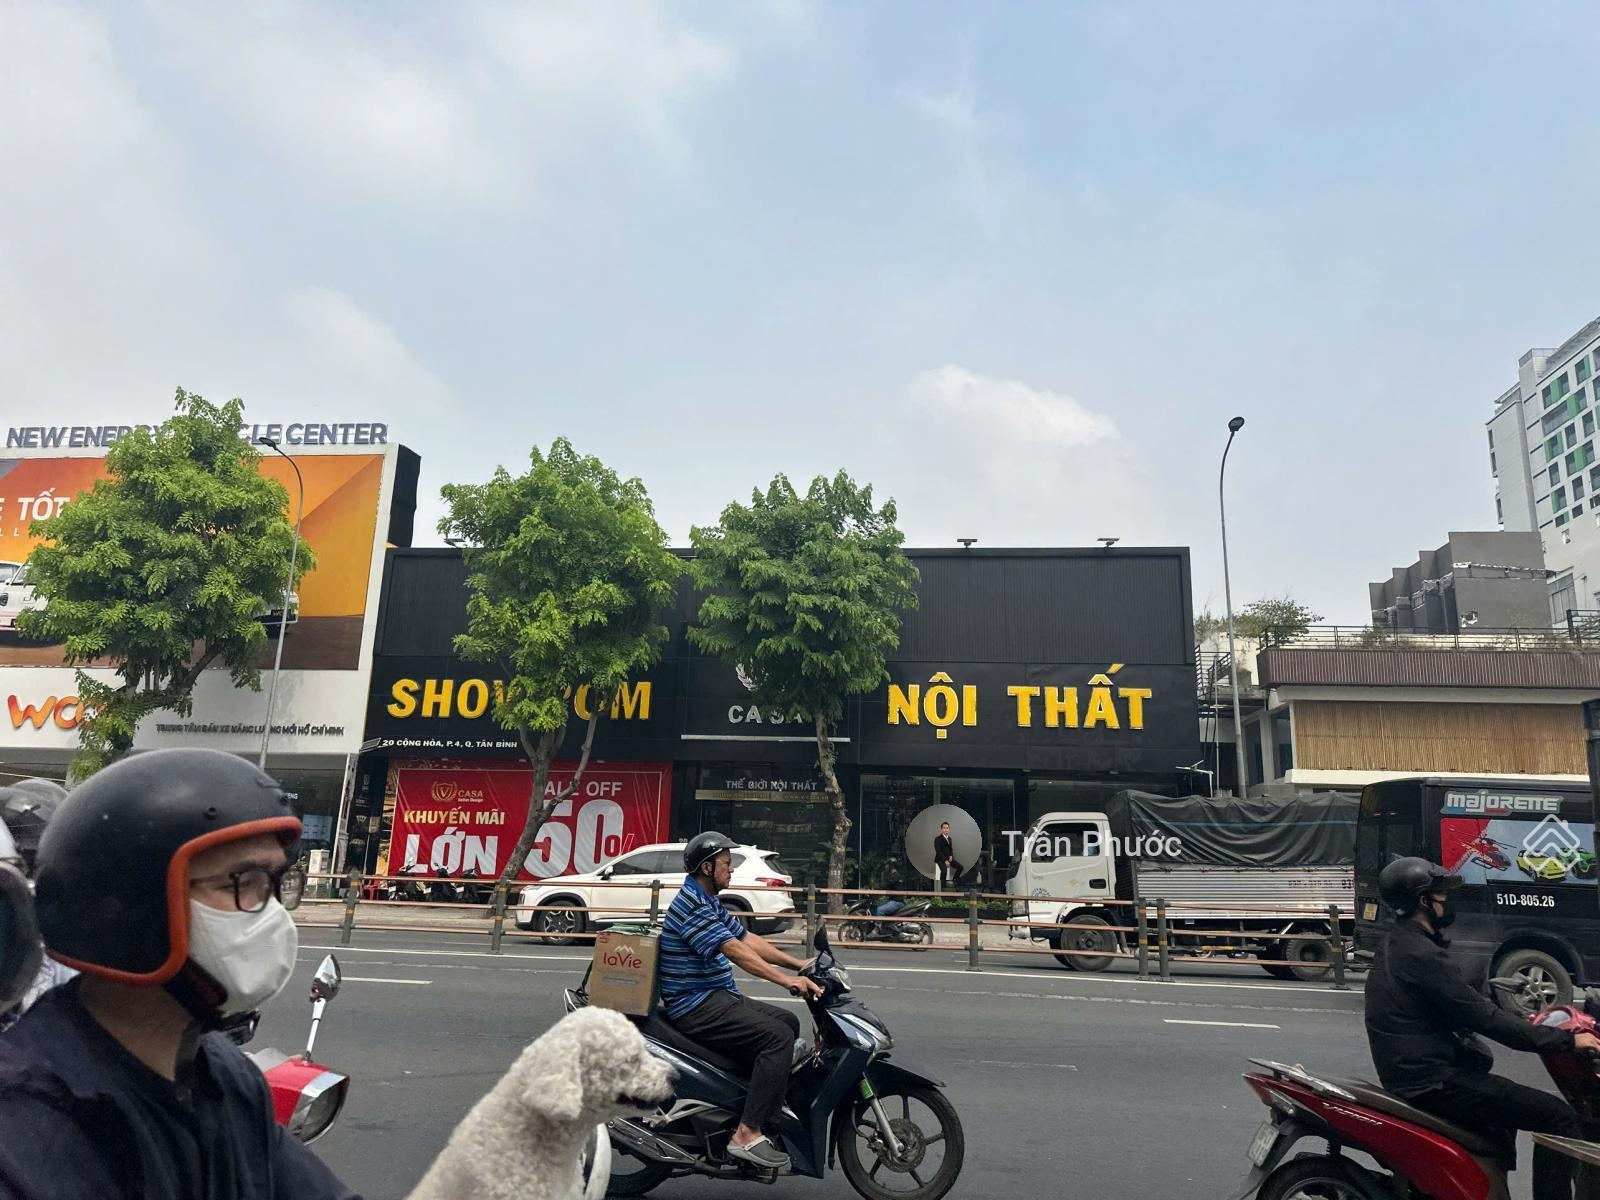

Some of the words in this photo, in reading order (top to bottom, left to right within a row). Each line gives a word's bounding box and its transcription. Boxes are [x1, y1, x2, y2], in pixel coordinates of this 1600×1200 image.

[7, 427, 68, 448] NEW
[69, 425, 173, 448] ENER
[286, 423, 388, 445] CENTER
[387, 679, 651, 720] SHOOM
[887, 671, 977, 739] NỘI
[1007, 663, 1152, 730] THẤT
[382, 739, 395, 747] 20
[423, 738, 444, 748] HÒA,
[476, 739, 493, 748] TÂN
[496, 739, 518, 748] BÌNH
[544, 781, 580, 796] AL
[586, 781, 623, 797] OFF
[726, 777, 746, 789] THẾ
[748, 778, 768, 790] GIỚI
[770, 779, 788, 792] NỘI
[790, 778, 817, 791] THẤT
[457, 790, 483, 798] CASA
[403, 806, 471, 825] KHUYẾN
[475, 808, 505, 825] MÃI
[399, 826, 499, 876] LỚN
[1496, 893, 1555, 908] 51D-805.26
